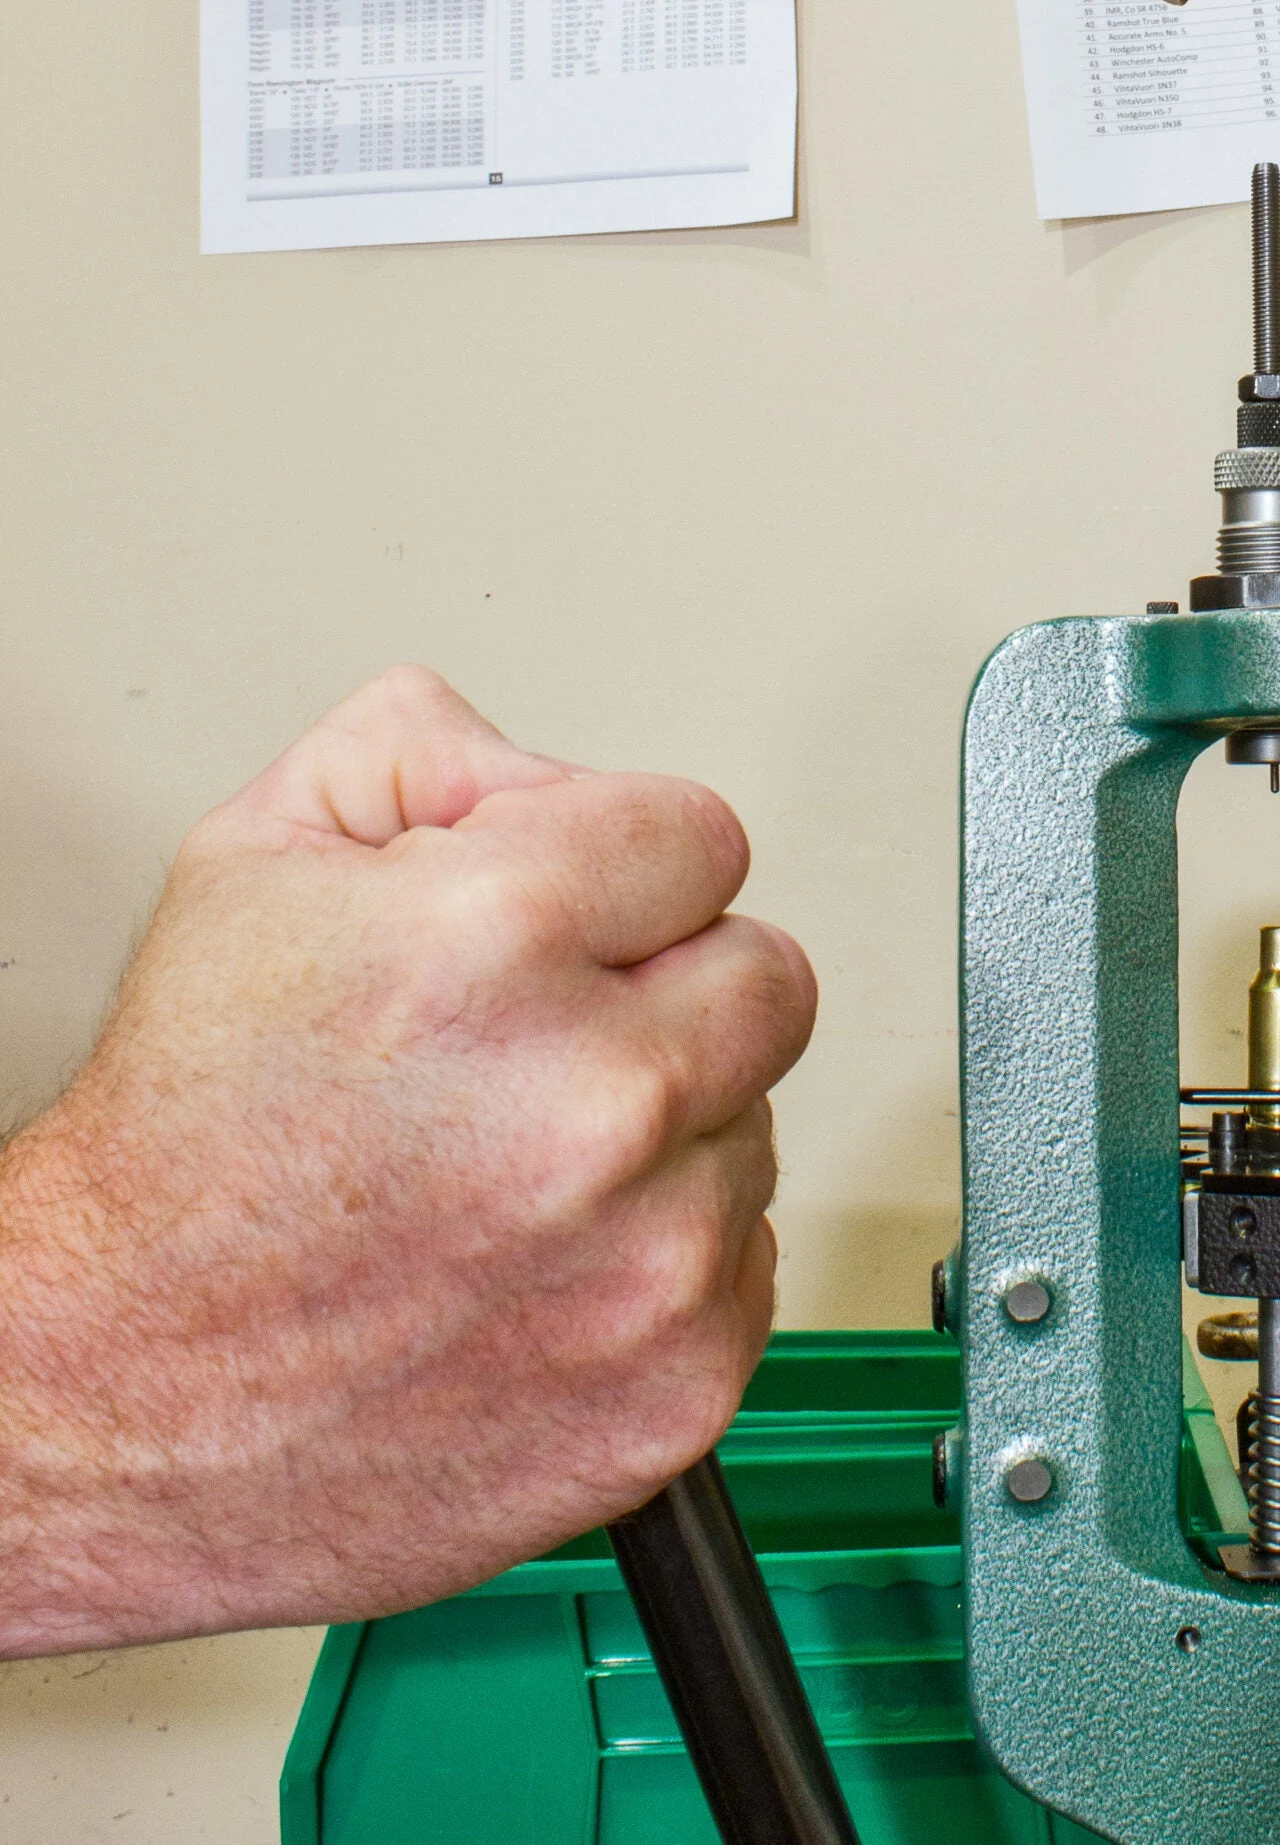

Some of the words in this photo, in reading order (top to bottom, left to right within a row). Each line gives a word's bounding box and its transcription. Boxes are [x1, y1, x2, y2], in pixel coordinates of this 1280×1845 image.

[1125, 6, 1135, 14] Co
[1137, 5, 1146, 13] SR
[1107, 19, 1140, 27] Ramshot
[1162, 16, 1179, 24] Blue
[1109, 31, 1141, 41] Accurate
[1144, 30, 1164, 39] Arms
[1110, 45, 1144, 54] Hodgdon
[1146, 43, 1164, 51] HS-6
[1111, 57, 1155, 67] Winchester
[1157, 54, 1198, 63] AutoComp
[1113, 71, 1146, 79] Ramshot
[1149, 68, 1188, 77] Silhouette
[1114, 84, 1155, 93] VihtaVuori
[1157, 81, 1177, 89] 3N37
[1116, 97, 1157, 106] VihtaVuori
[1158, 95, 1179, 103] N350
[1117, 110, 1152, 119] Hodgdon
[1153, 108, 1172, 116] HS-7
[1118, 123, 1160, 132] VihtaVuori
